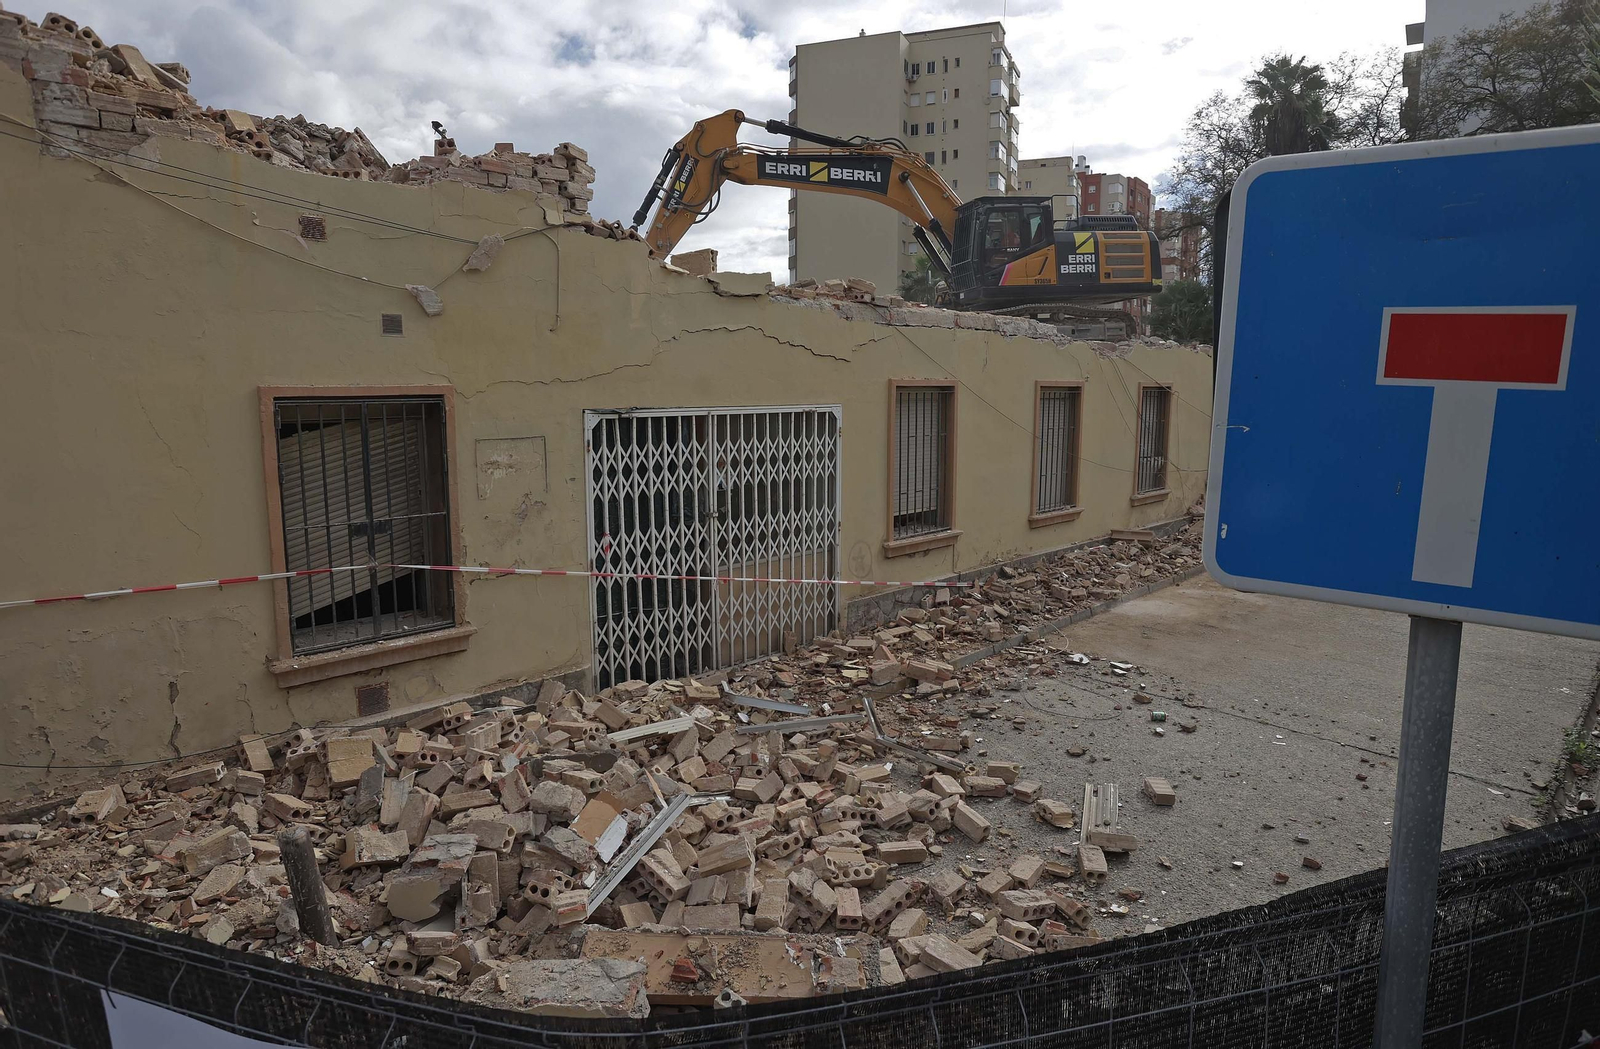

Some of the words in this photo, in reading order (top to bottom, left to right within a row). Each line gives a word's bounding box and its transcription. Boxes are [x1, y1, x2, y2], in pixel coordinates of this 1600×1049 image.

[765, 161, 807, 177] ERRI
[830, 167, 882, 183] BERRI
[1068, 254, 1095, 264] ERRI
[1060, 264, 1096, 274] BERRI
